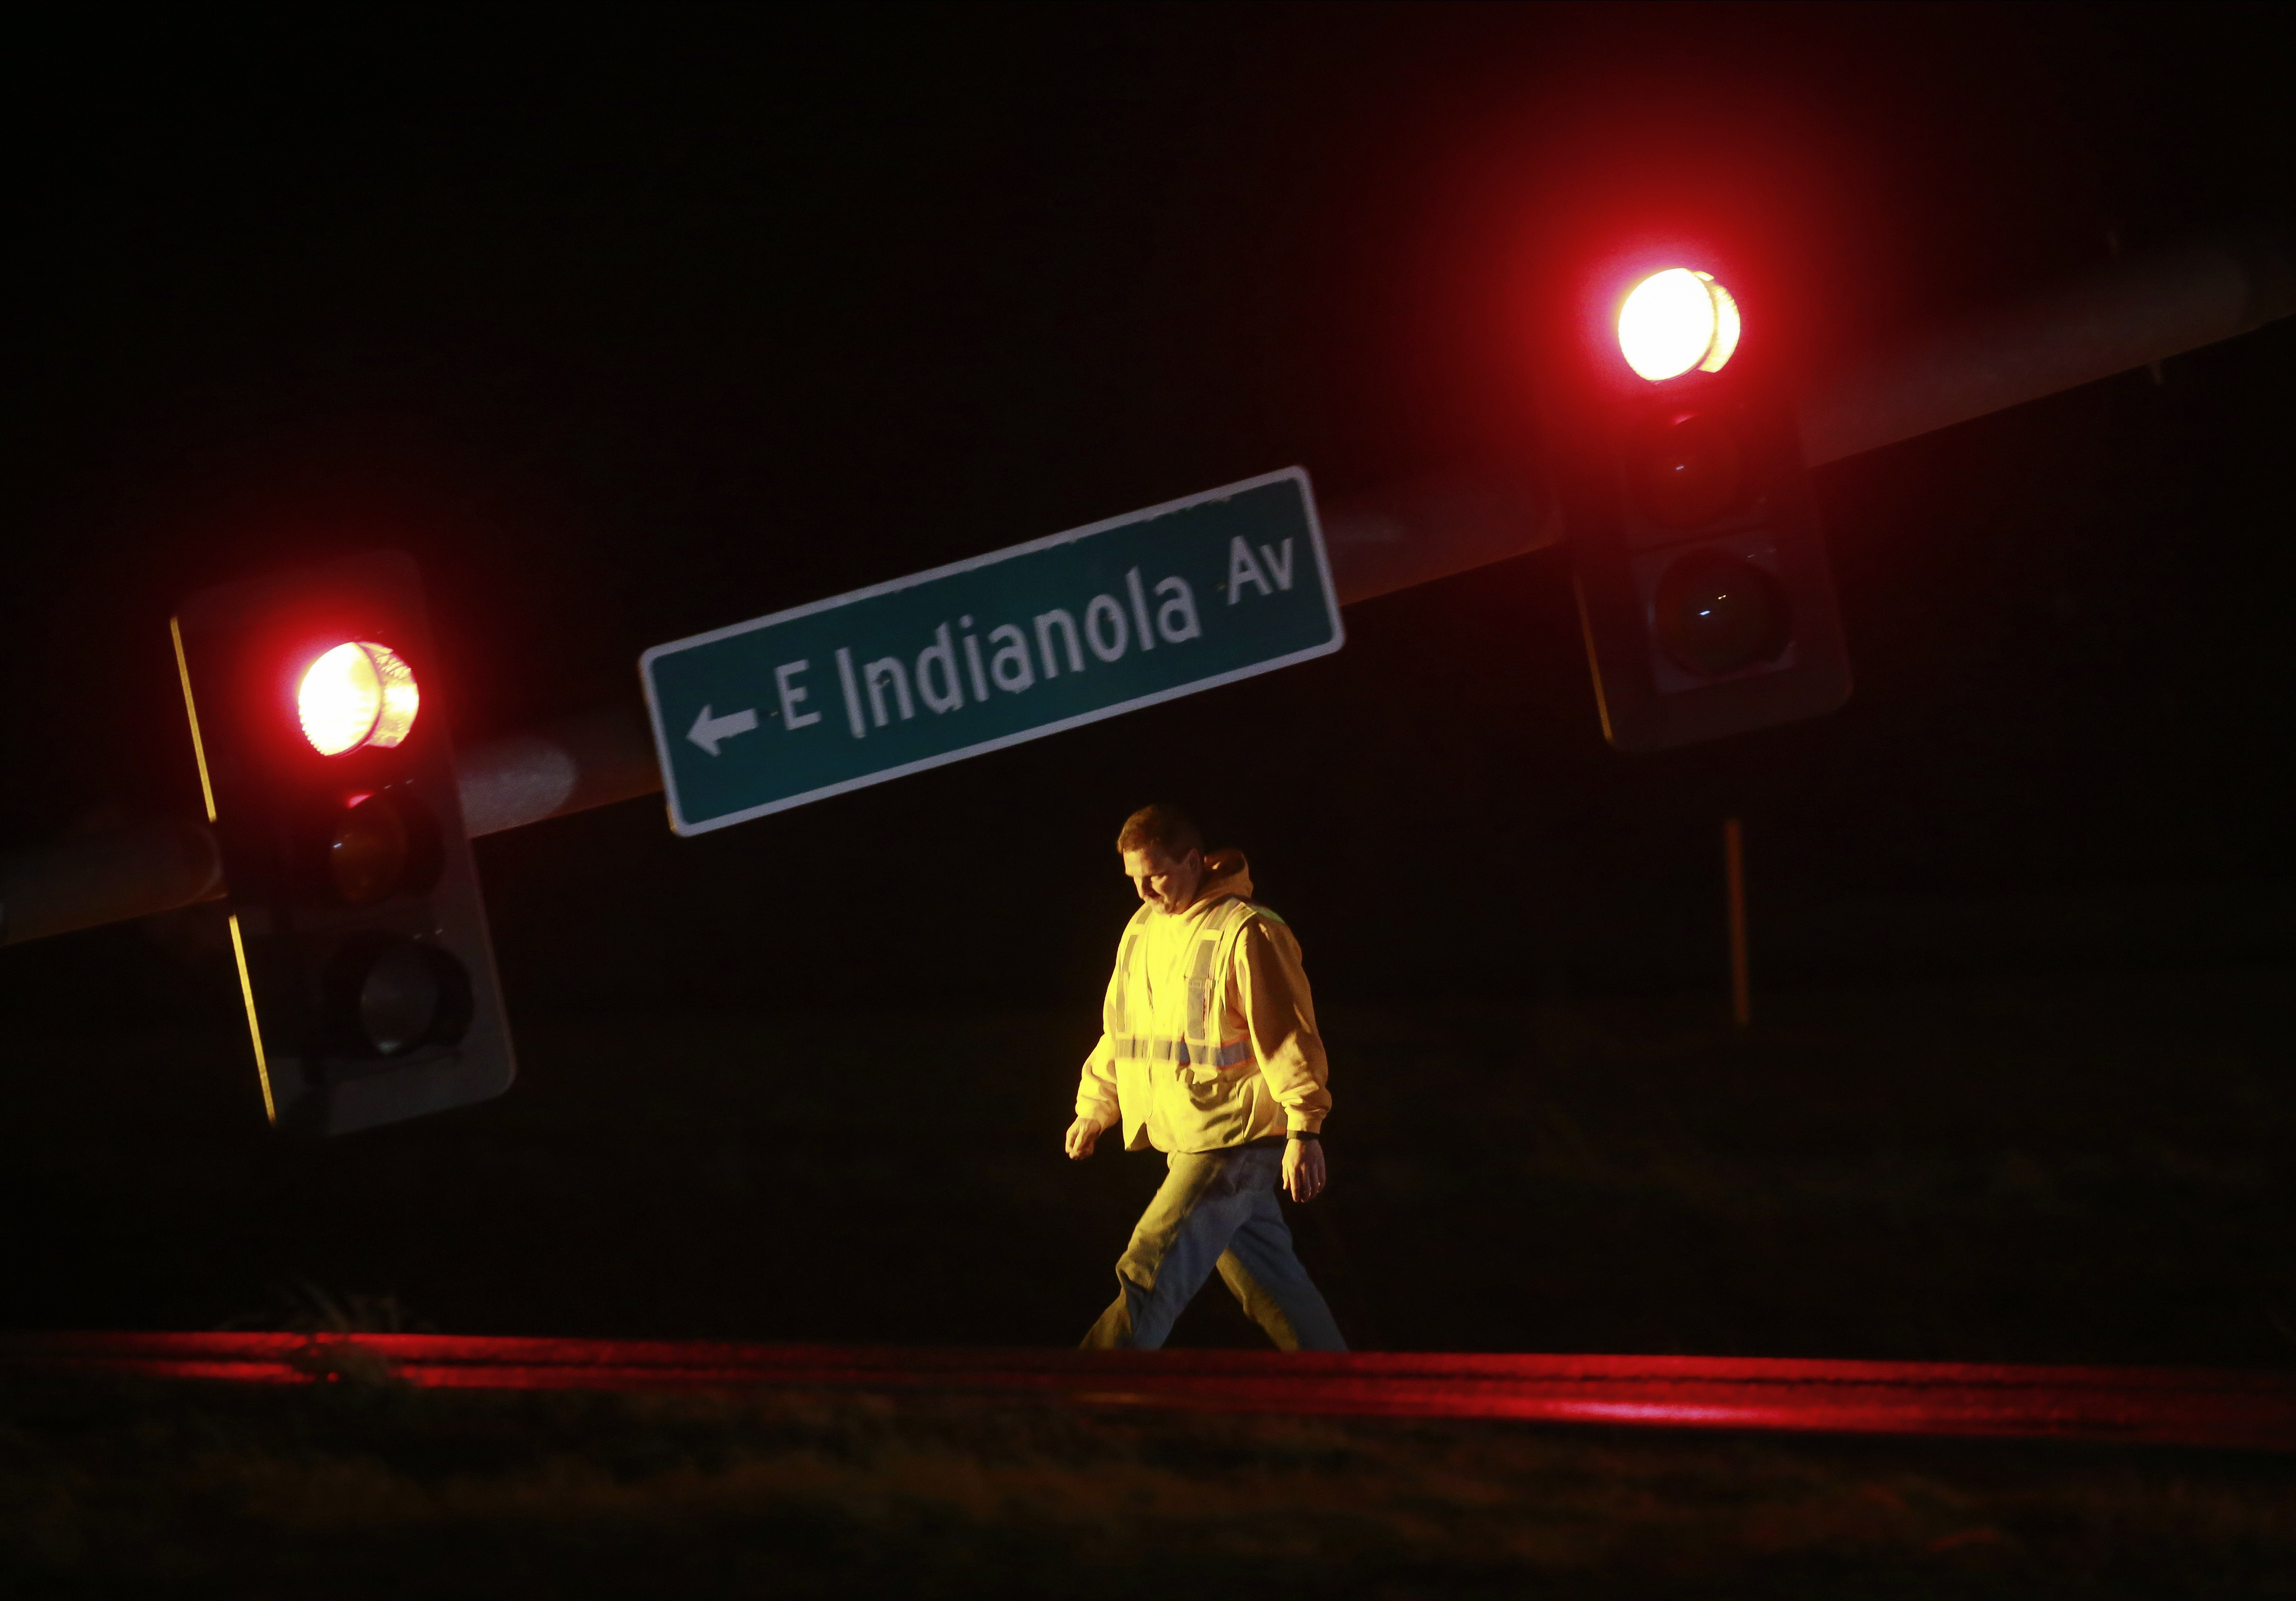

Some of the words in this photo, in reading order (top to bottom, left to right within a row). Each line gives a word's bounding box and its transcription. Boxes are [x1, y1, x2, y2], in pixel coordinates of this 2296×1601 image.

[774, 659, 821, 730] E
[836, 566, 1200, 738] Indianola
[1226, 536, 1294, 605] Av
